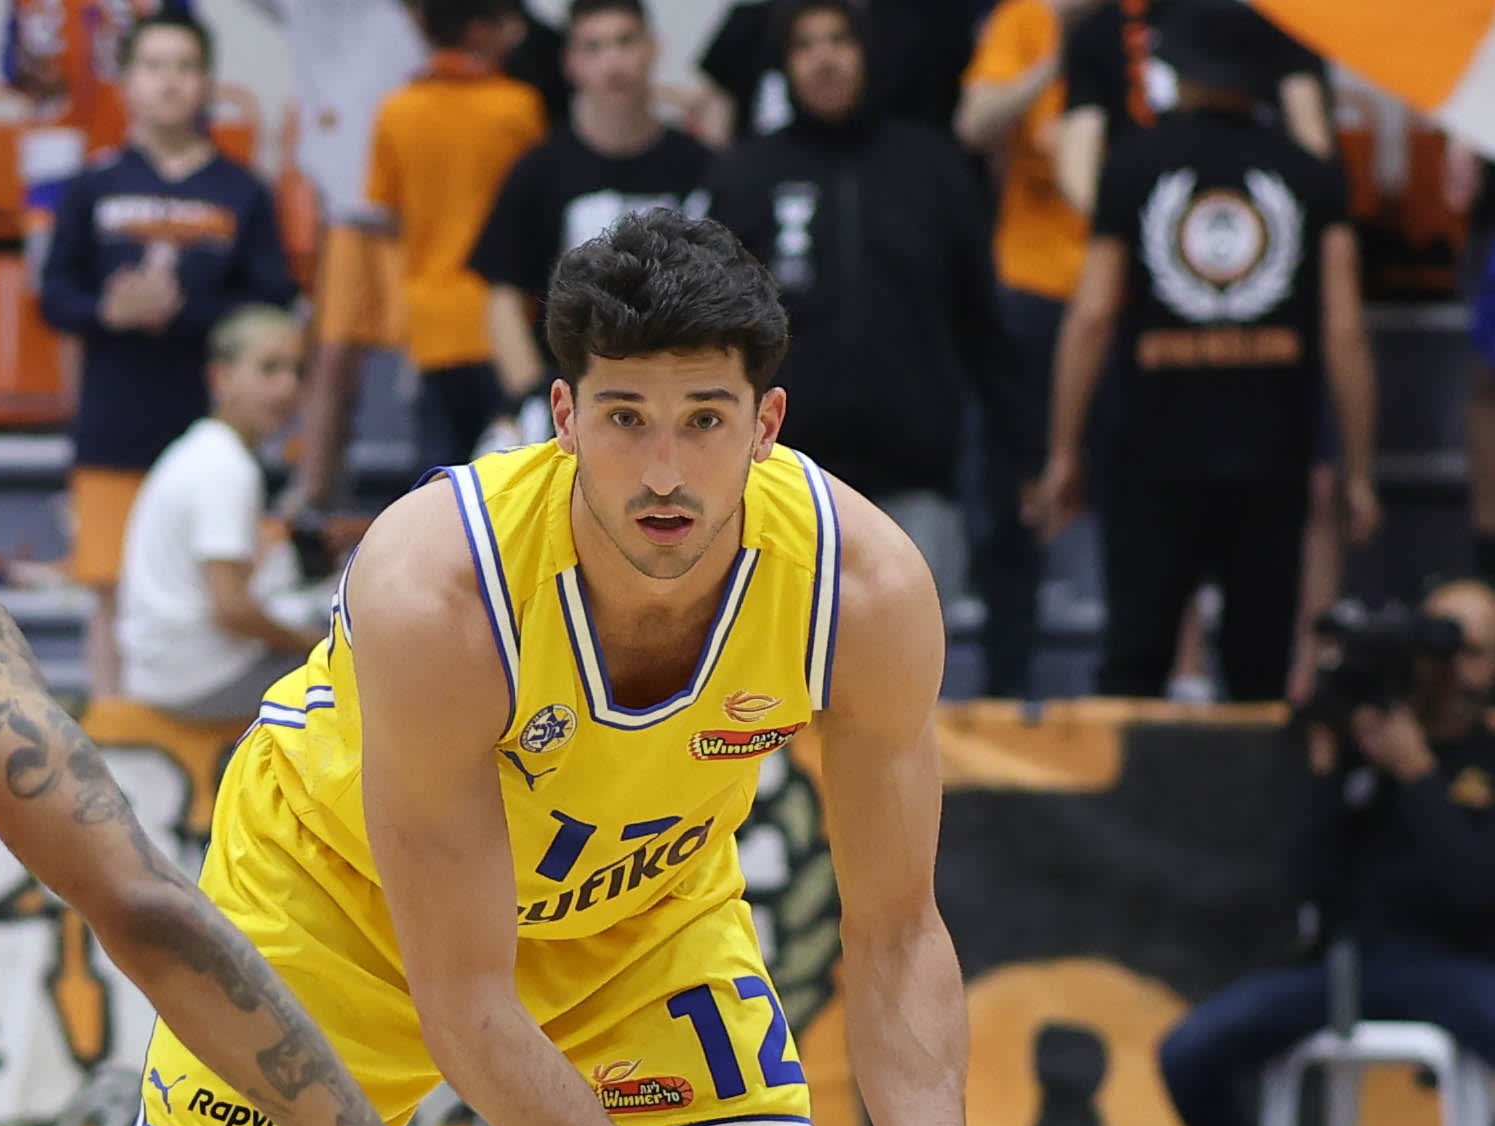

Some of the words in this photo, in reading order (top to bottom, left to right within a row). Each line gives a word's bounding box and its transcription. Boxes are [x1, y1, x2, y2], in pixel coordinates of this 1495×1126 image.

[701, 738, 776, 756] Winner
[666, 975, 807, 1101] 12
[602, 1090, 663, 1108] Winner
